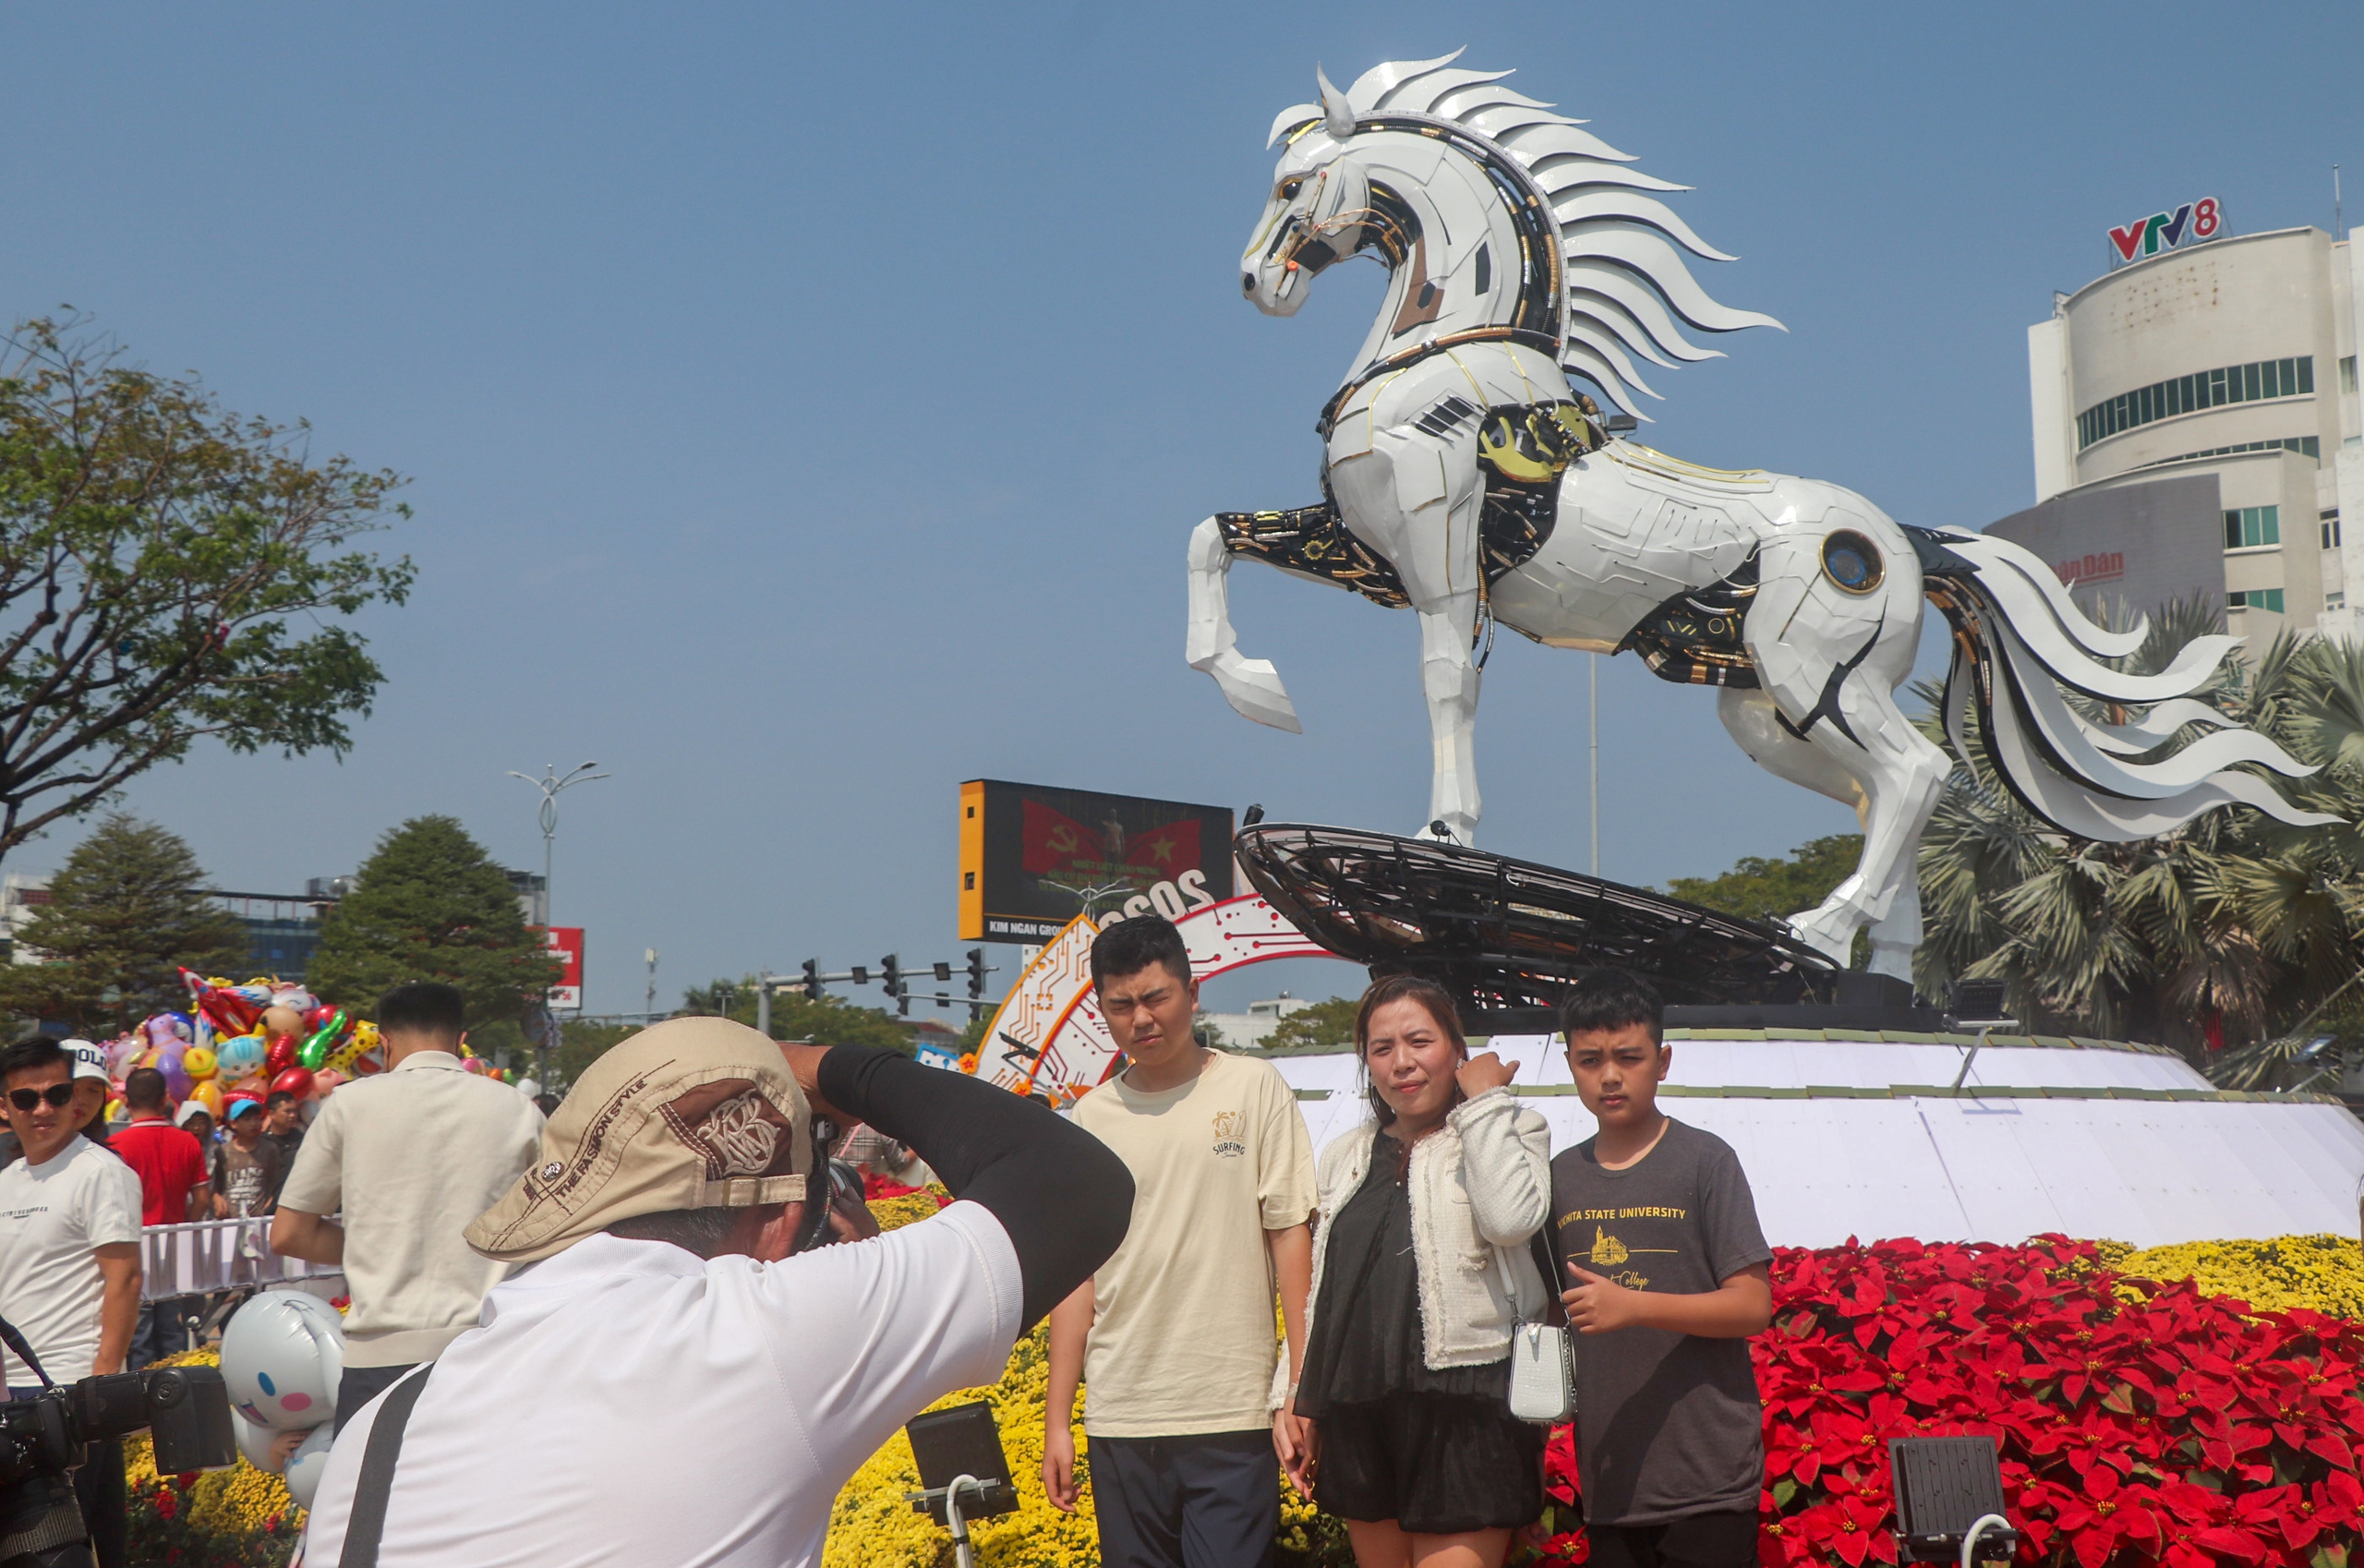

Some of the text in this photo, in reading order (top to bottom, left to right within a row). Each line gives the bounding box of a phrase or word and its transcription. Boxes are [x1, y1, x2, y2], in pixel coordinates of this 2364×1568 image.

[989, 921, 1008, 934] KIM
[1010, 923, 1038, 935] NGAN
[555, 1080, 647, 1198] THE FASHION STYLE
[1212, 1141, 1246, 1155] SURFING
[1585, 1209, 1616, 1220] STATE
[1619, 1206, 1686, 1220] UNIVERSITY
[1619, 1270, 1650, 1292] College
